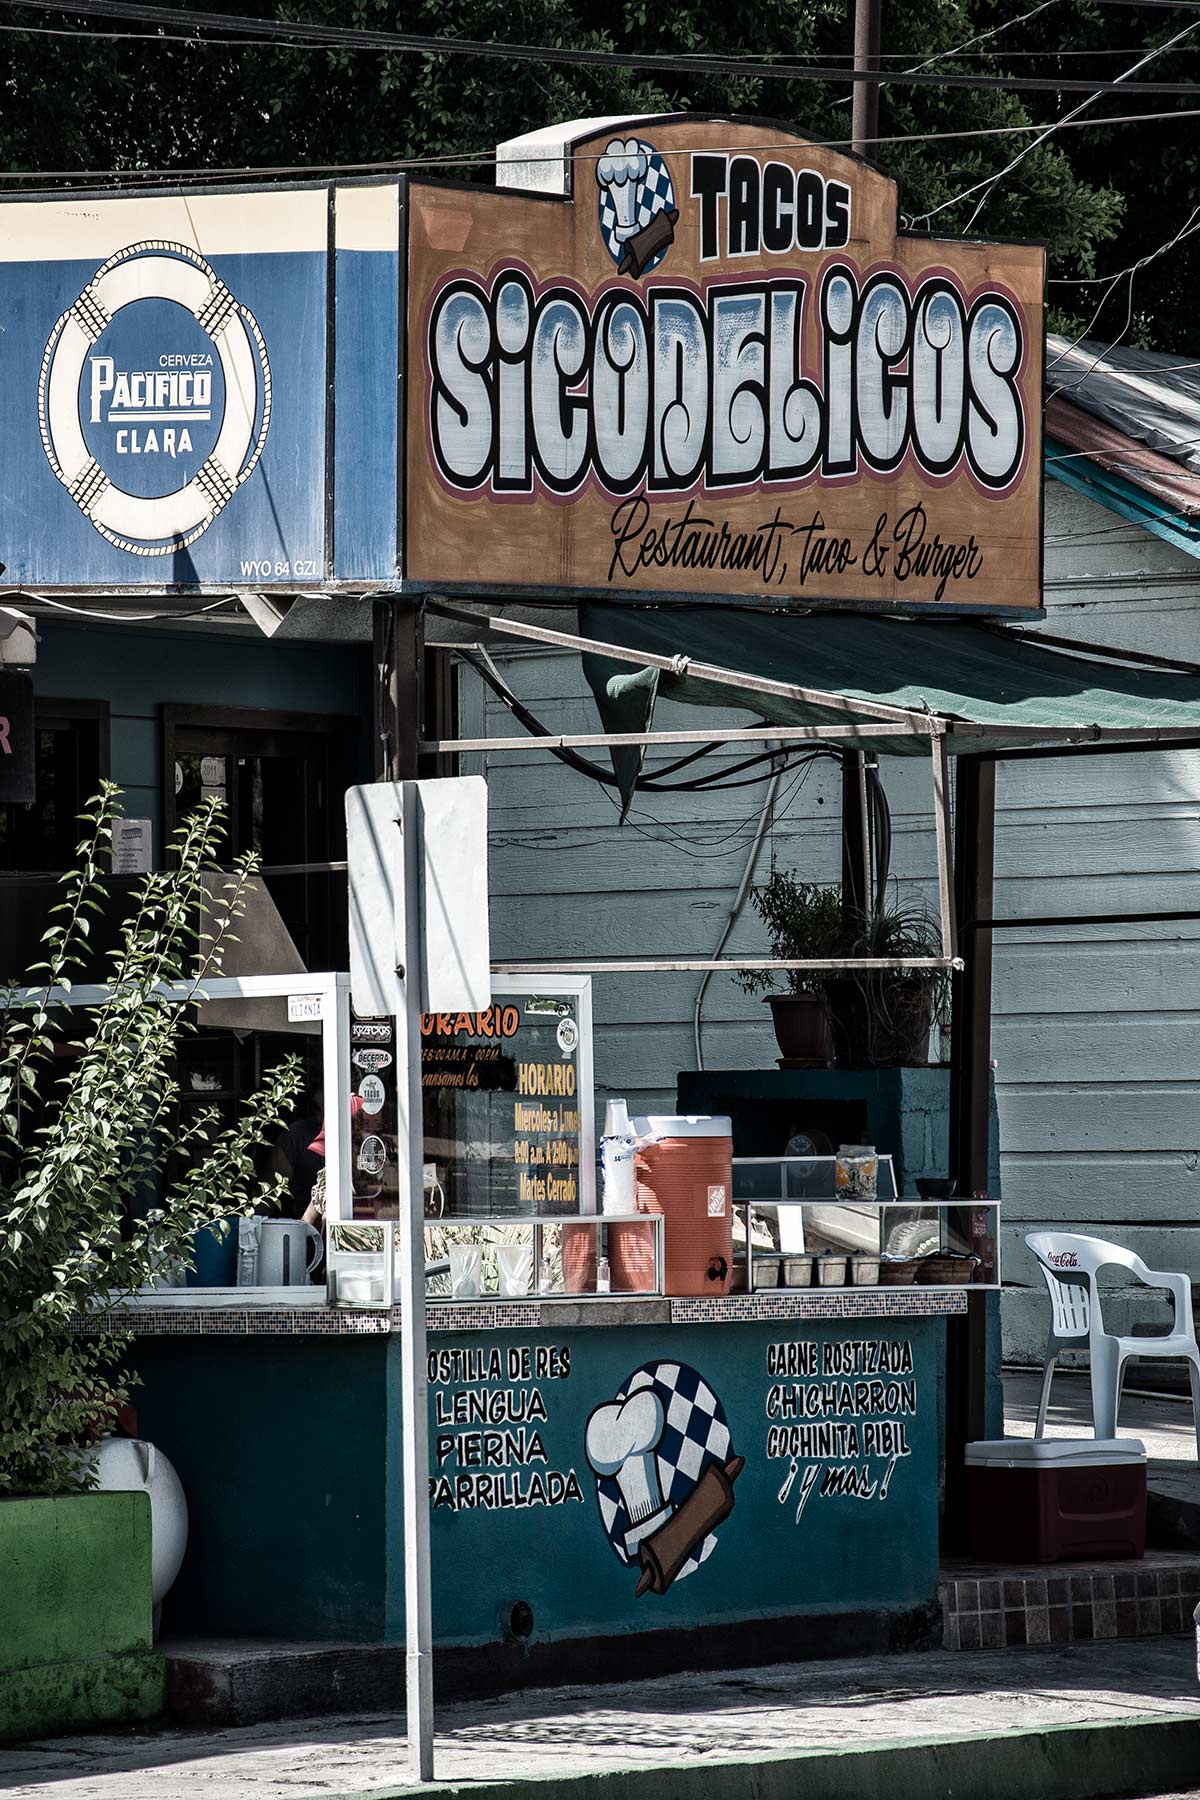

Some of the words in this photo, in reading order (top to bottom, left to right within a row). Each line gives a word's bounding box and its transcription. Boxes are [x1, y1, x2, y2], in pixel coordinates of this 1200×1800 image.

[690, 153, 853, 262] TACOS
[159, 354, 213, 367] CERVEZA
[89, 356, 212, 423] PACIFICO
[116, 428, 193, 458] CLARA
[240, 560, 272, 577] WYO
[275, 560, 290, 576] 64
[862, 512, 890, 578] &
[893, 501, 984, 601] Burger
[420, 1006, 520, 1037] ORARIO
[358, 1053, 389, 1063] BECERRA
[519, 1063, 575, 1096] HORARIO
[515, 1102, 551, 1132] Miercoles
[553, 1110, 558, 1132] a
[514, 1140, 529, 1164] 8:00
[546, 1140, 551, 1164] A
[552, 1141, 567, 1164] 2:00
[520, 1172, 545, 1201] Martes
[547, 1172, 577, 1201] Cerrado
[427, 1348, 501, 1384] OSTILLA
[507, 1346, 531, 1382] DE
[536, 1345, 571, 1380] RES
[767, 1342, 818, 1377] CARNE
[823, 1340, 913, 1376] ROSTIZADA
[436, 1387, 548, 1427] LENGUA
[766, 1379, 916, 1420] CHICHARRON
[436, 1427, 549, 1467] PIERNA
[767, 1421, 859, 1459] COCHINITA
[862, 1420, 911, 1457] PIBIL
